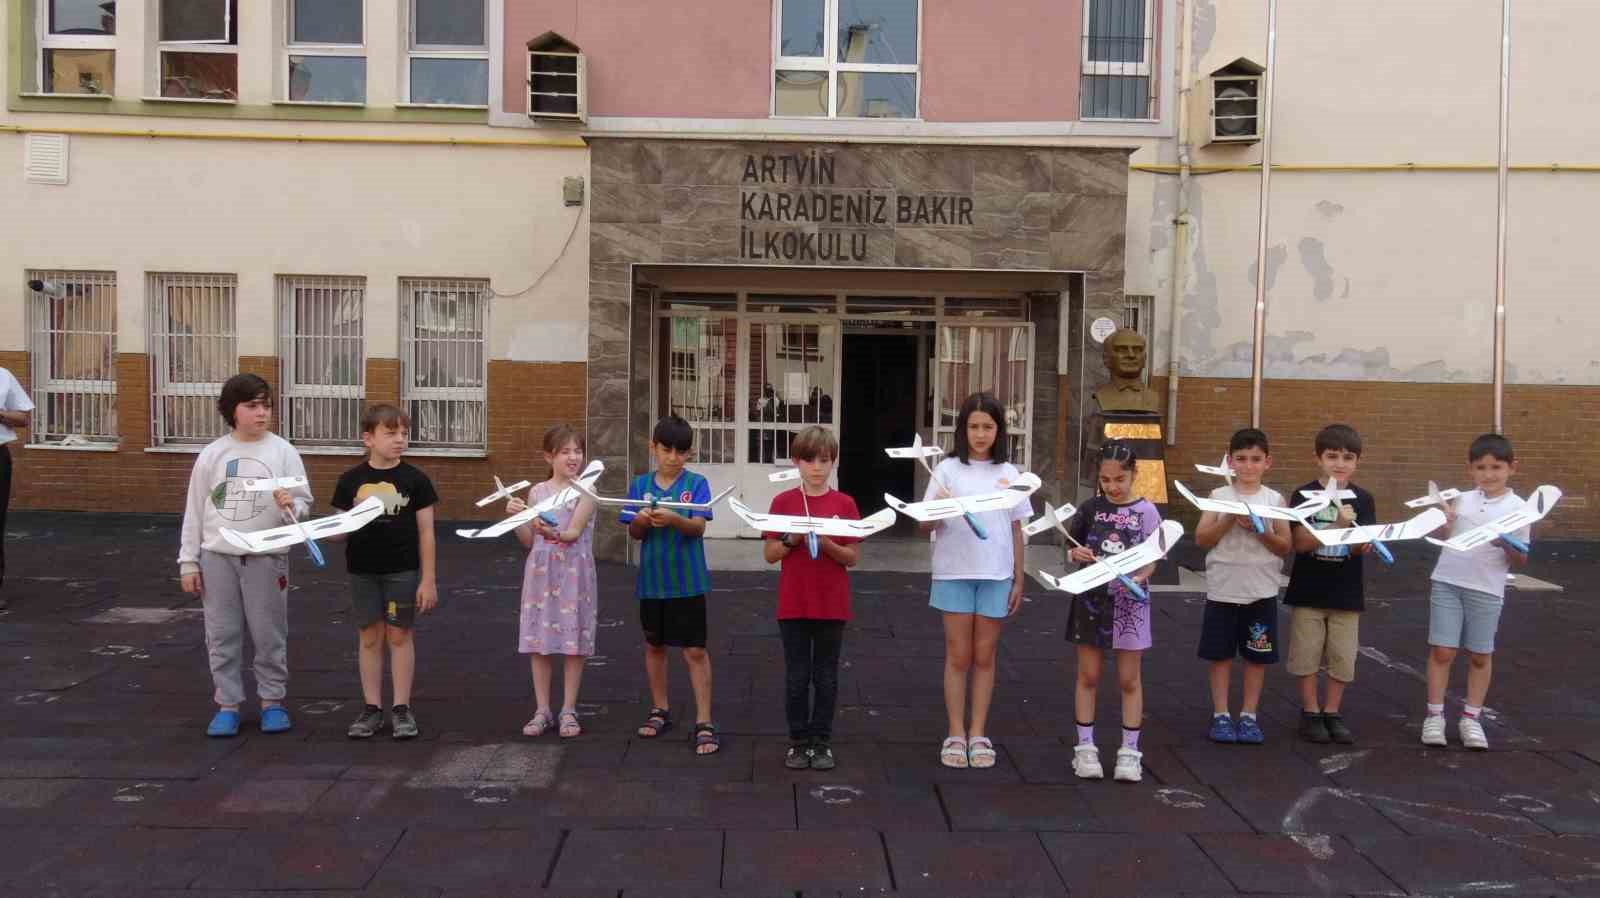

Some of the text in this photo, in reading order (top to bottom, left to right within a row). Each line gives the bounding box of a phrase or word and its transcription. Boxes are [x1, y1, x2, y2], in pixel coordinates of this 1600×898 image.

[742, 150, 835, 185] ARTVİN
[741, 189, 974, 225] KARADENİZ BAKIR
[740, 225, 867, 262] İLKOKULU
